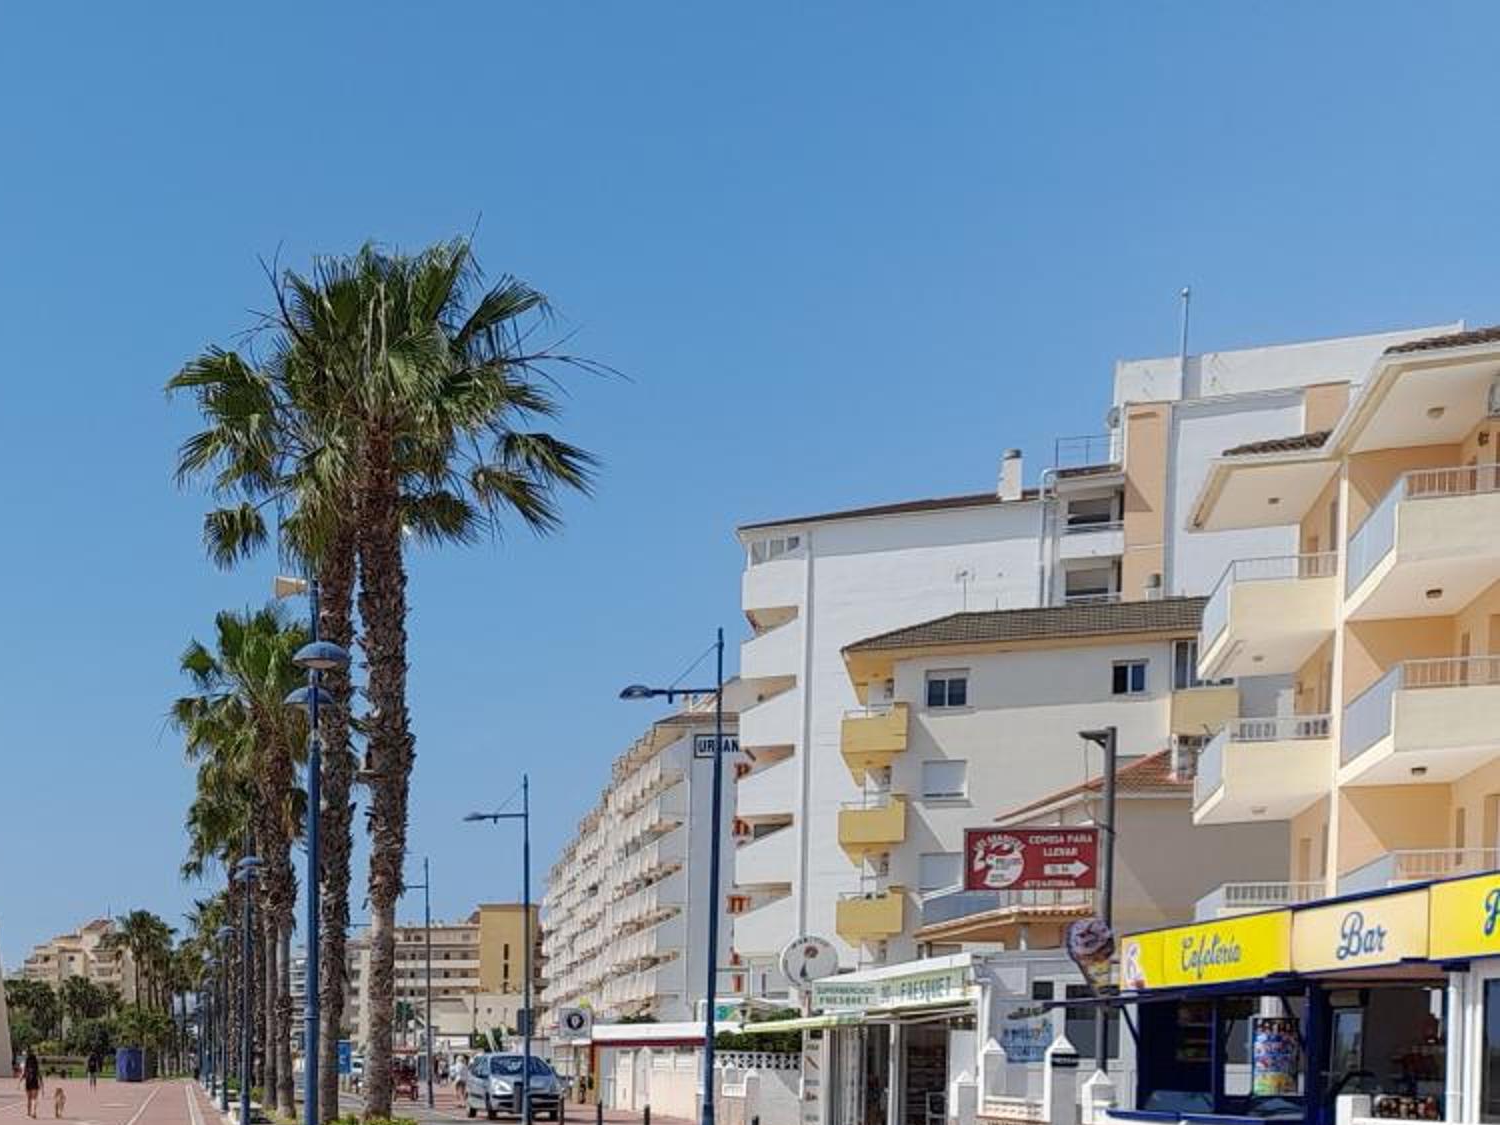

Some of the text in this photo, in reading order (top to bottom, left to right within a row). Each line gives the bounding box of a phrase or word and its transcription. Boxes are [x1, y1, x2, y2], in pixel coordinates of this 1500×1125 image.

[1043, 847, 1078, 857] LLEVAR
[1336, 911, 1387, 960] Bar
[901, 975, 951, 1001] FRESQUET
